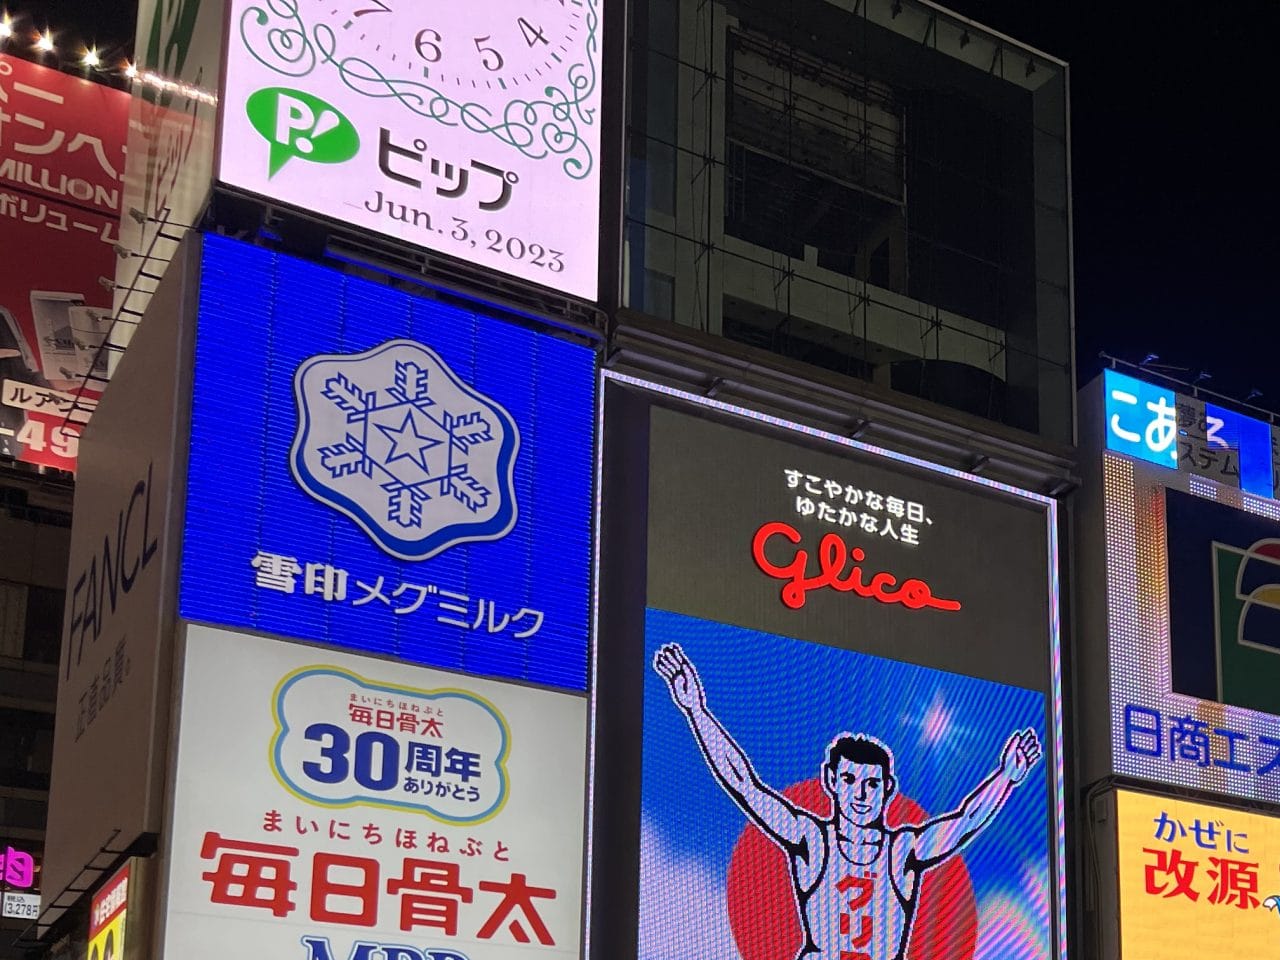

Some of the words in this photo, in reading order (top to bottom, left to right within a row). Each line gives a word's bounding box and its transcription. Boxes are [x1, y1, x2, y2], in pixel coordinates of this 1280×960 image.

[415, 29, 442, 63] 6
[474, 36, 504, 71] 5
[518, 17, 548, 49] 4
[378, 127, 520, 212] ピップ
[363, 191, 443, 234] Jun.
[451, 217, 478, 250] 3,
[486, 234, 566, 274] 2023
[784, 468, 933, 525] すこやかな毎日、
[795, 496, 920, 546] ゆたかな人生
[66, 462, 157, 681] FANCL
[752, 521, 961, 609] Glico
[251, 549, 545, 638] 雪印メグミルク
[349, 704, 443, 739] 毎日骨太
[350, 692, 444, 717] まいにちほねぶと
[404, 776, 480, 802] ありがとう
[262, 809, 512, 862] まいにちほねぶと
[1153, 811, 1249, 854] かぜに
[200, 832, 557, 946] 毎日骨太
[1143, 847, 1260, 911] 改源
